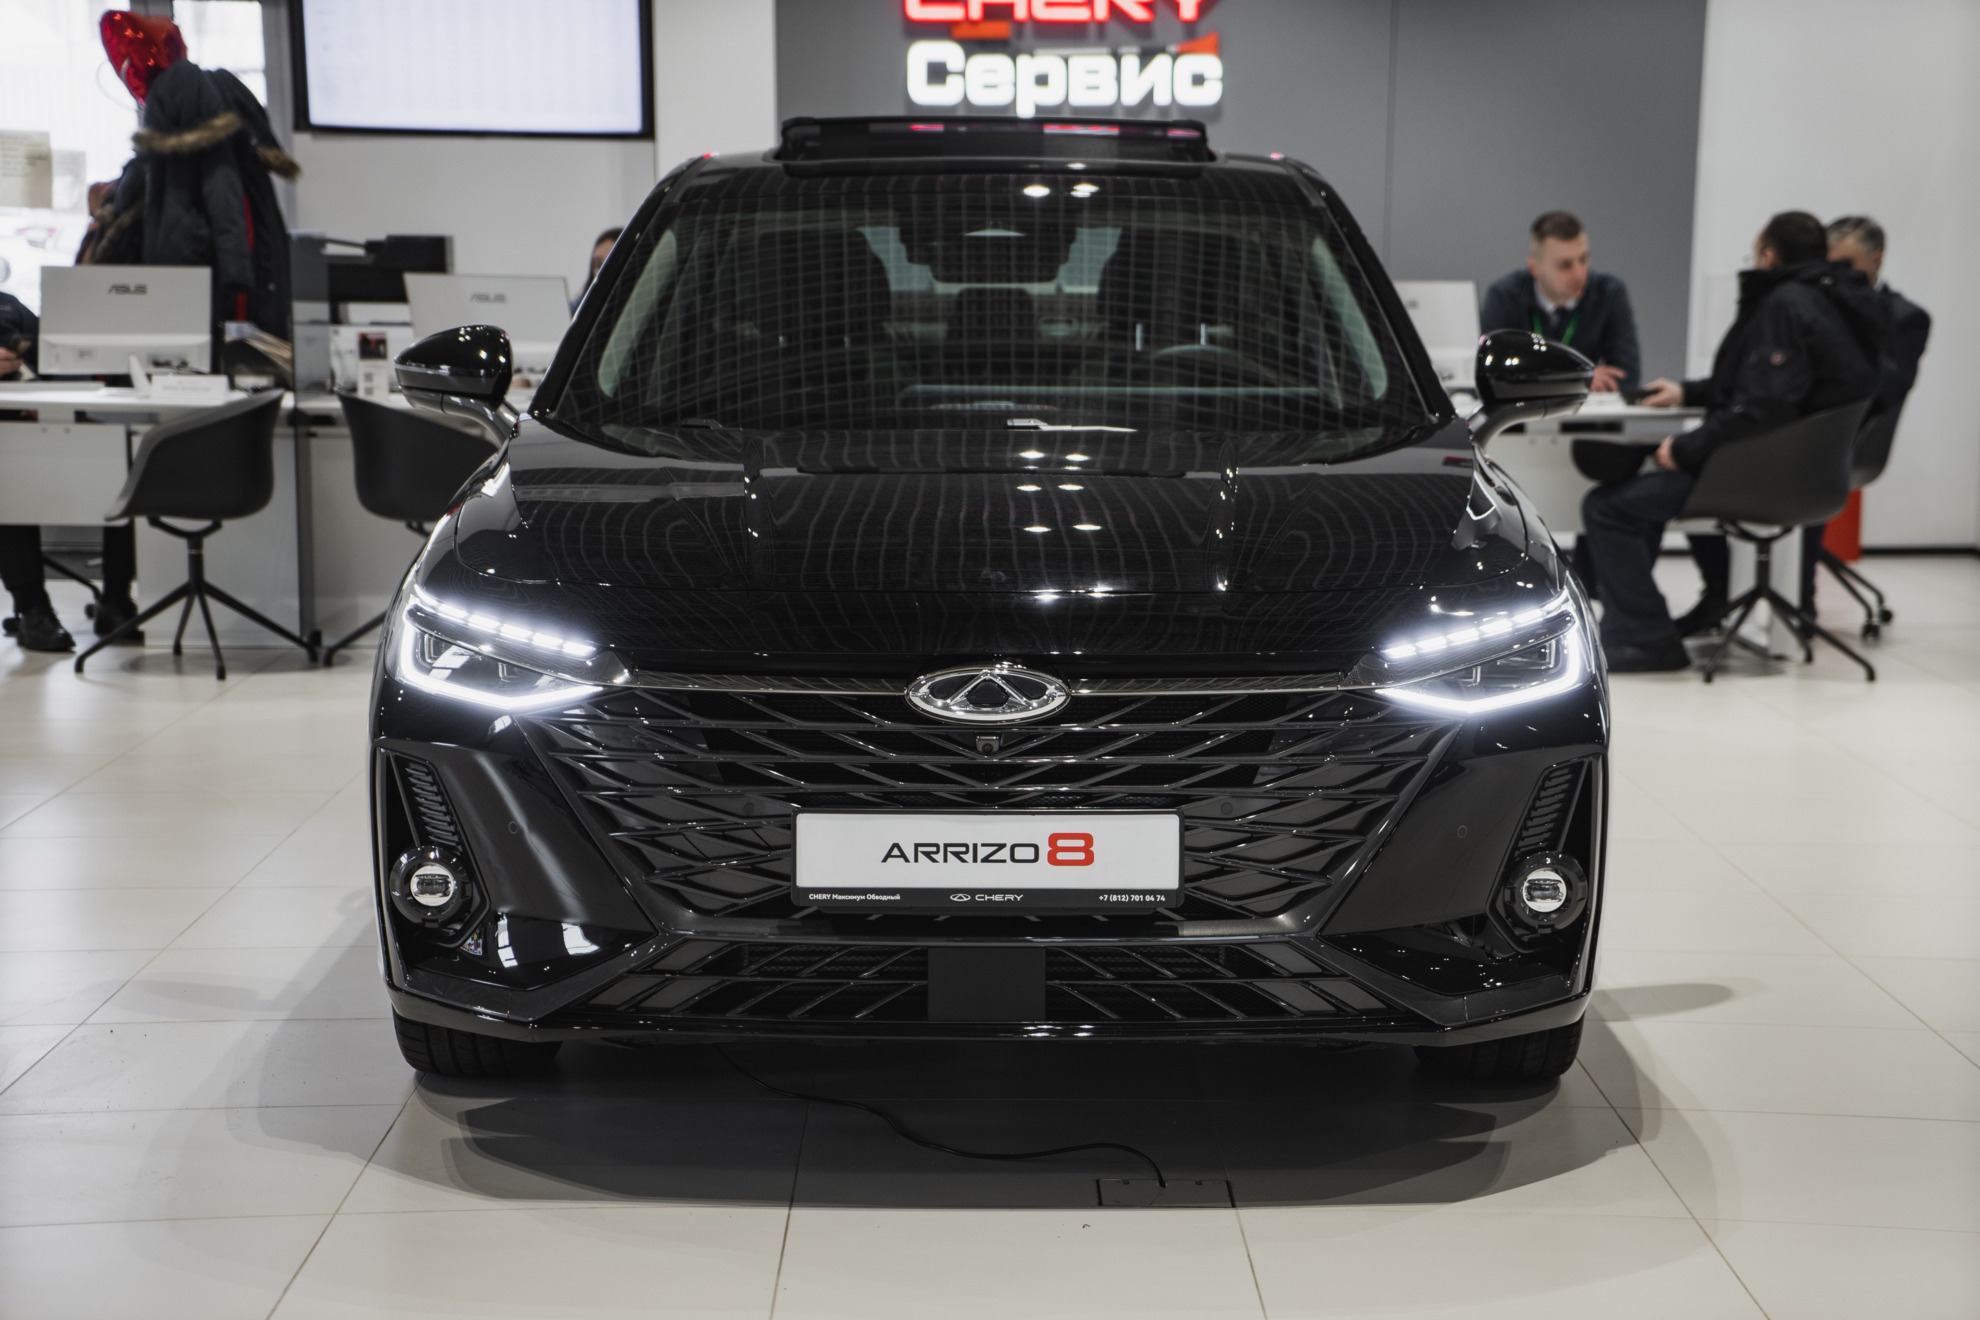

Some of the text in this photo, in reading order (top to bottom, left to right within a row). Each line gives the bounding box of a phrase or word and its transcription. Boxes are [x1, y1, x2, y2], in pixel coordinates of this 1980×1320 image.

[906, 39, 1224, 118] Сервис
[107, 282, 149, 296] ASUS
[881, 832, 1095, 867] ARRIZO 8
[832, 893, 866, 902] Максимум
[866, 893, 901, 901] Обводный
[975, 894, 1024, 902] CHERY
[1099, 894, 1166, 903] +7 (812) 701 04 74
